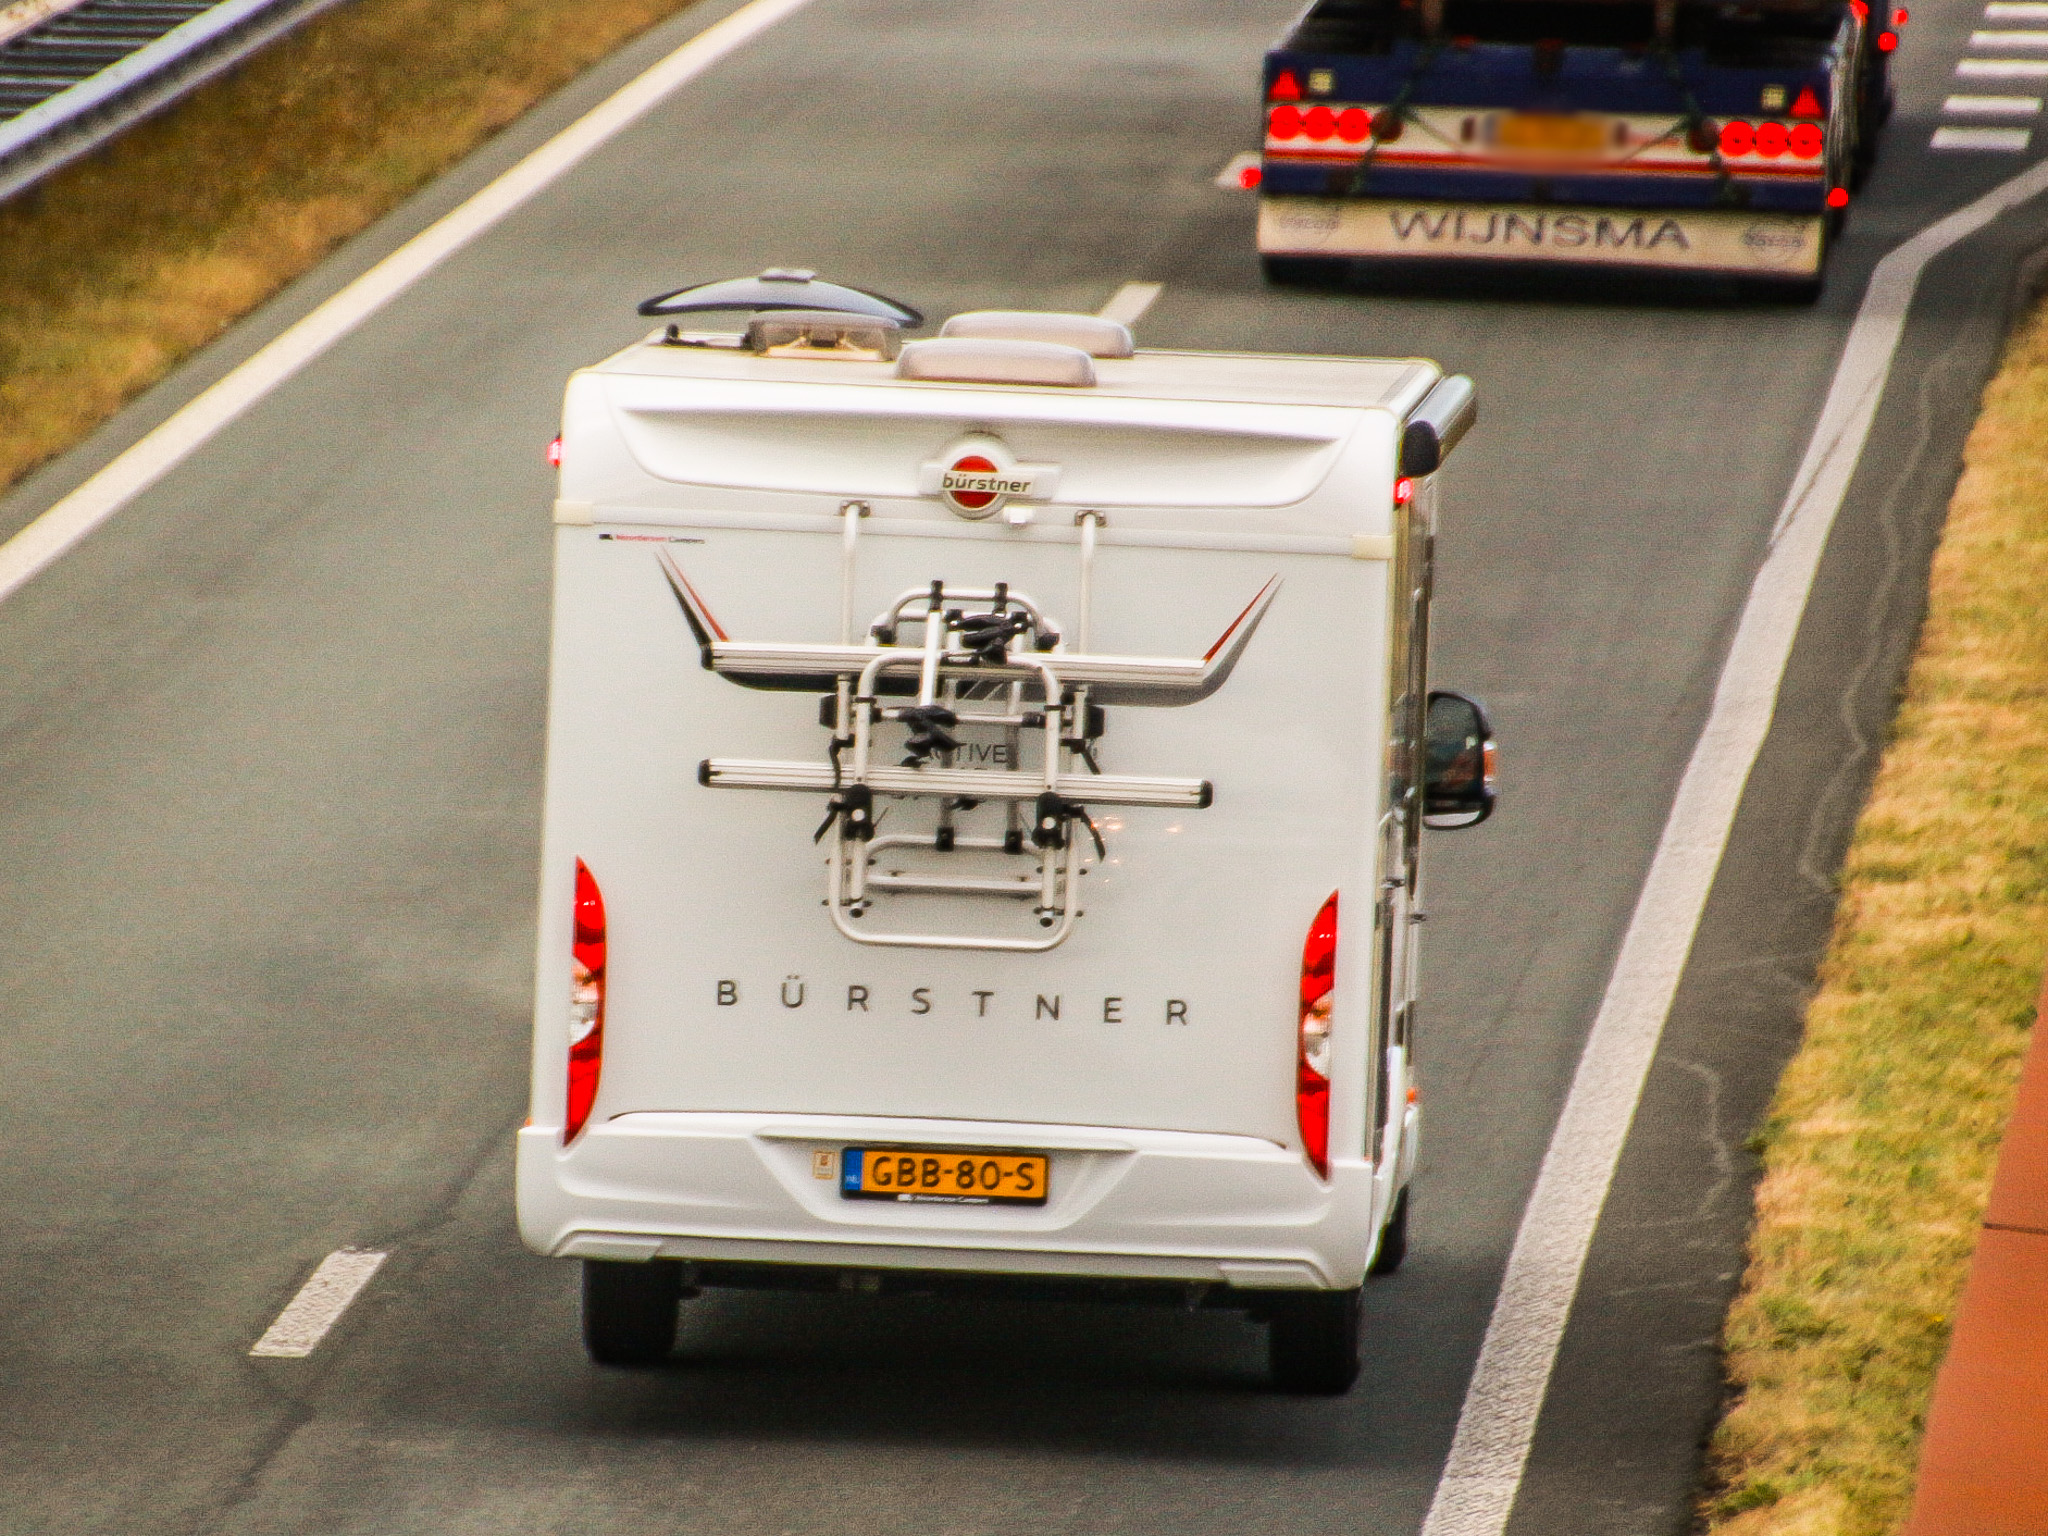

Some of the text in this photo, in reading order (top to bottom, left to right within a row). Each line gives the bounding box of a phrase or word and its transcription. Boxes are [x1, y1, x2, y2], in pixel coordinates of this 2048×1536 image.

[1390, 211, 1690, 250] WIJNSMA
[942, 473, 1031, 492] bürstner
[716, 975, 1189, 1026] BÜRSTNER
[872, 1156, 1034, 1191] GBB-80-S
